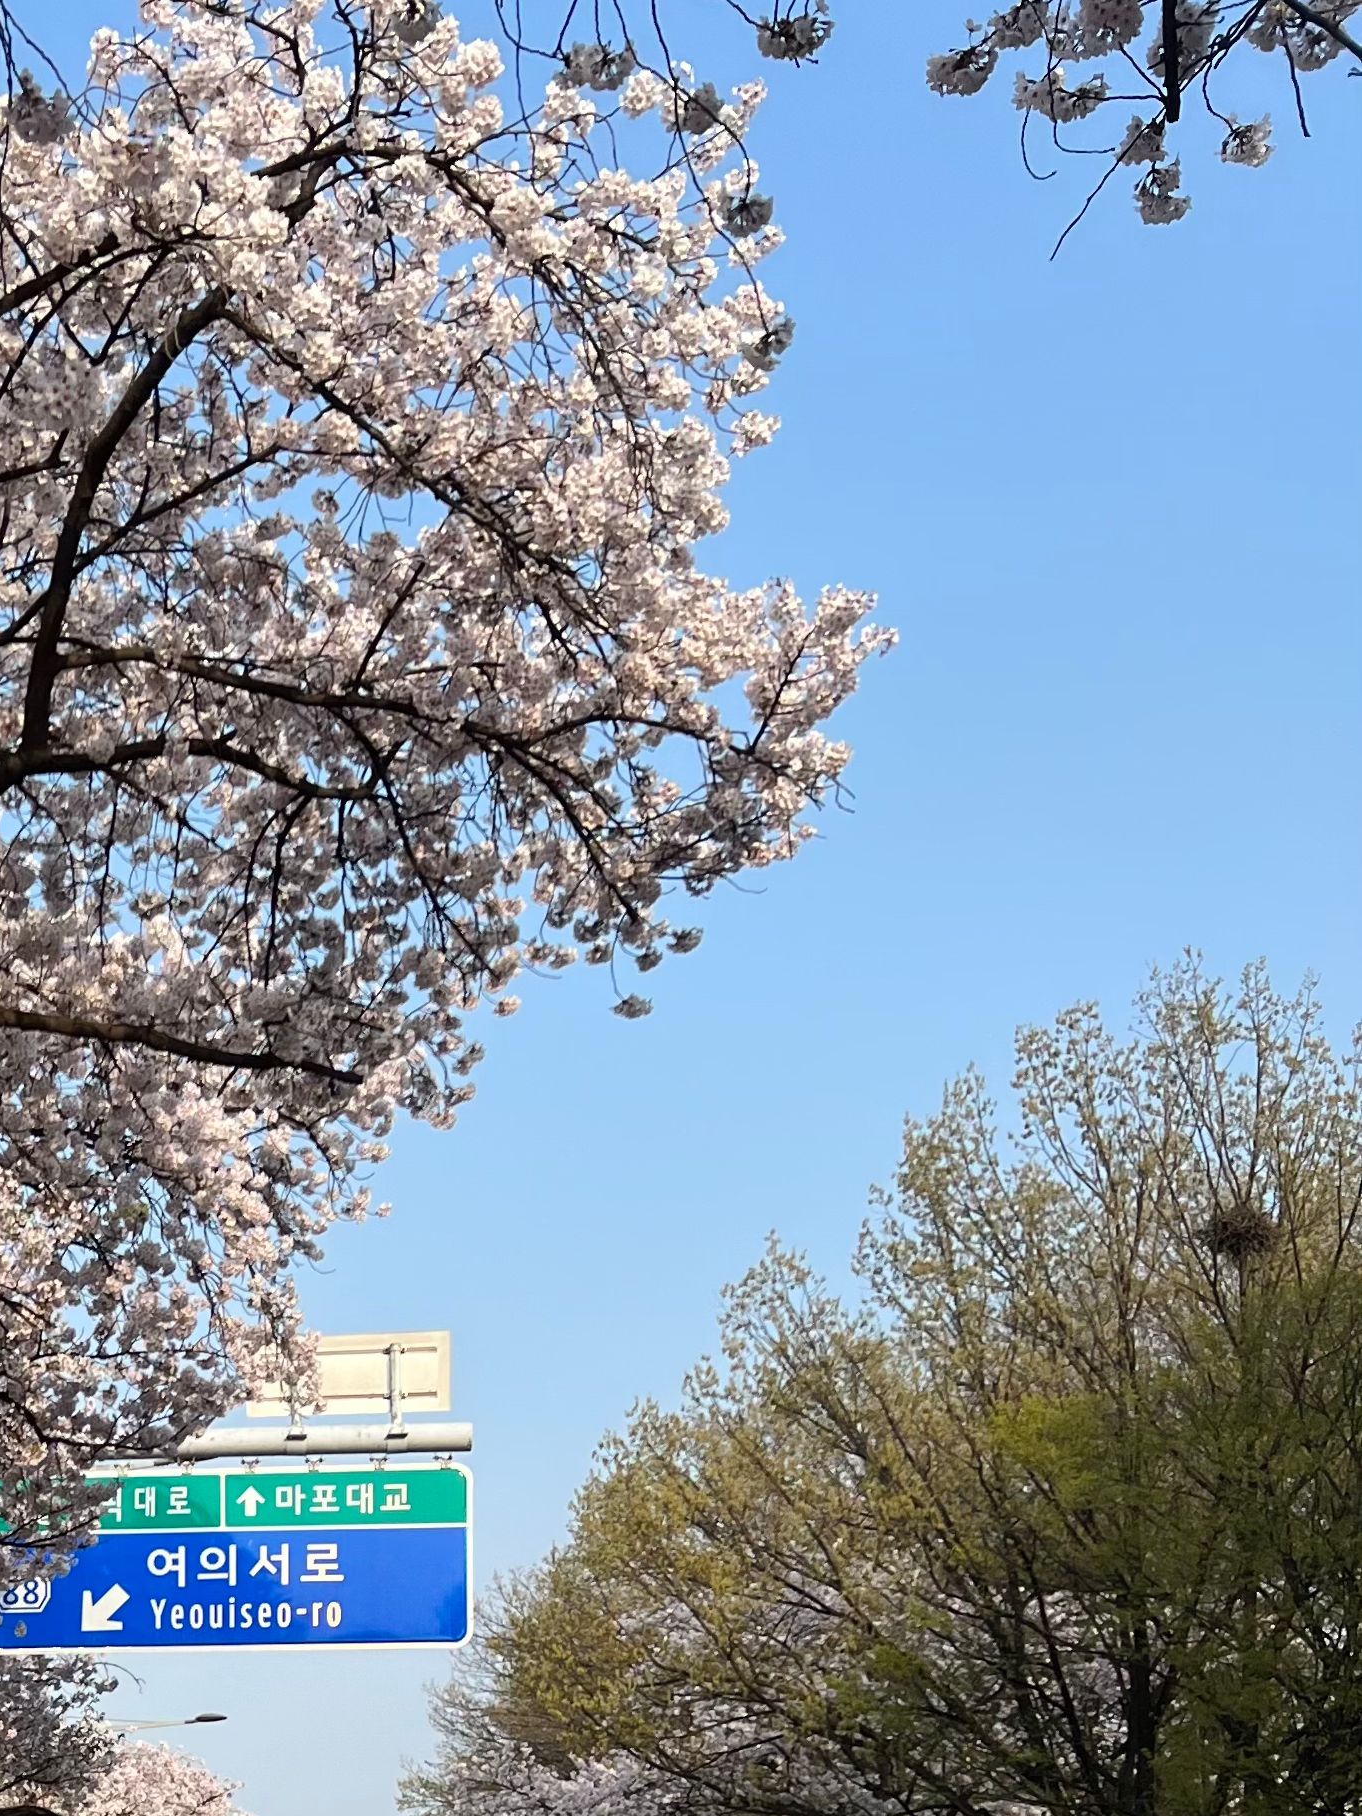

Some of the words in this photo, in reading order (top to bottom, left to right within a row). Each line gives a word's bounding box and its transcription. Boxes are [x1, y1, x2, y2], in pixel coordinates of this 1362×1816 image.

[274, 1482, 412, 1516] 마포대교
[146, 1542, 345, 1588] 여의서로
[150, 1596, 342, 1630] Yeouiseo-ro
